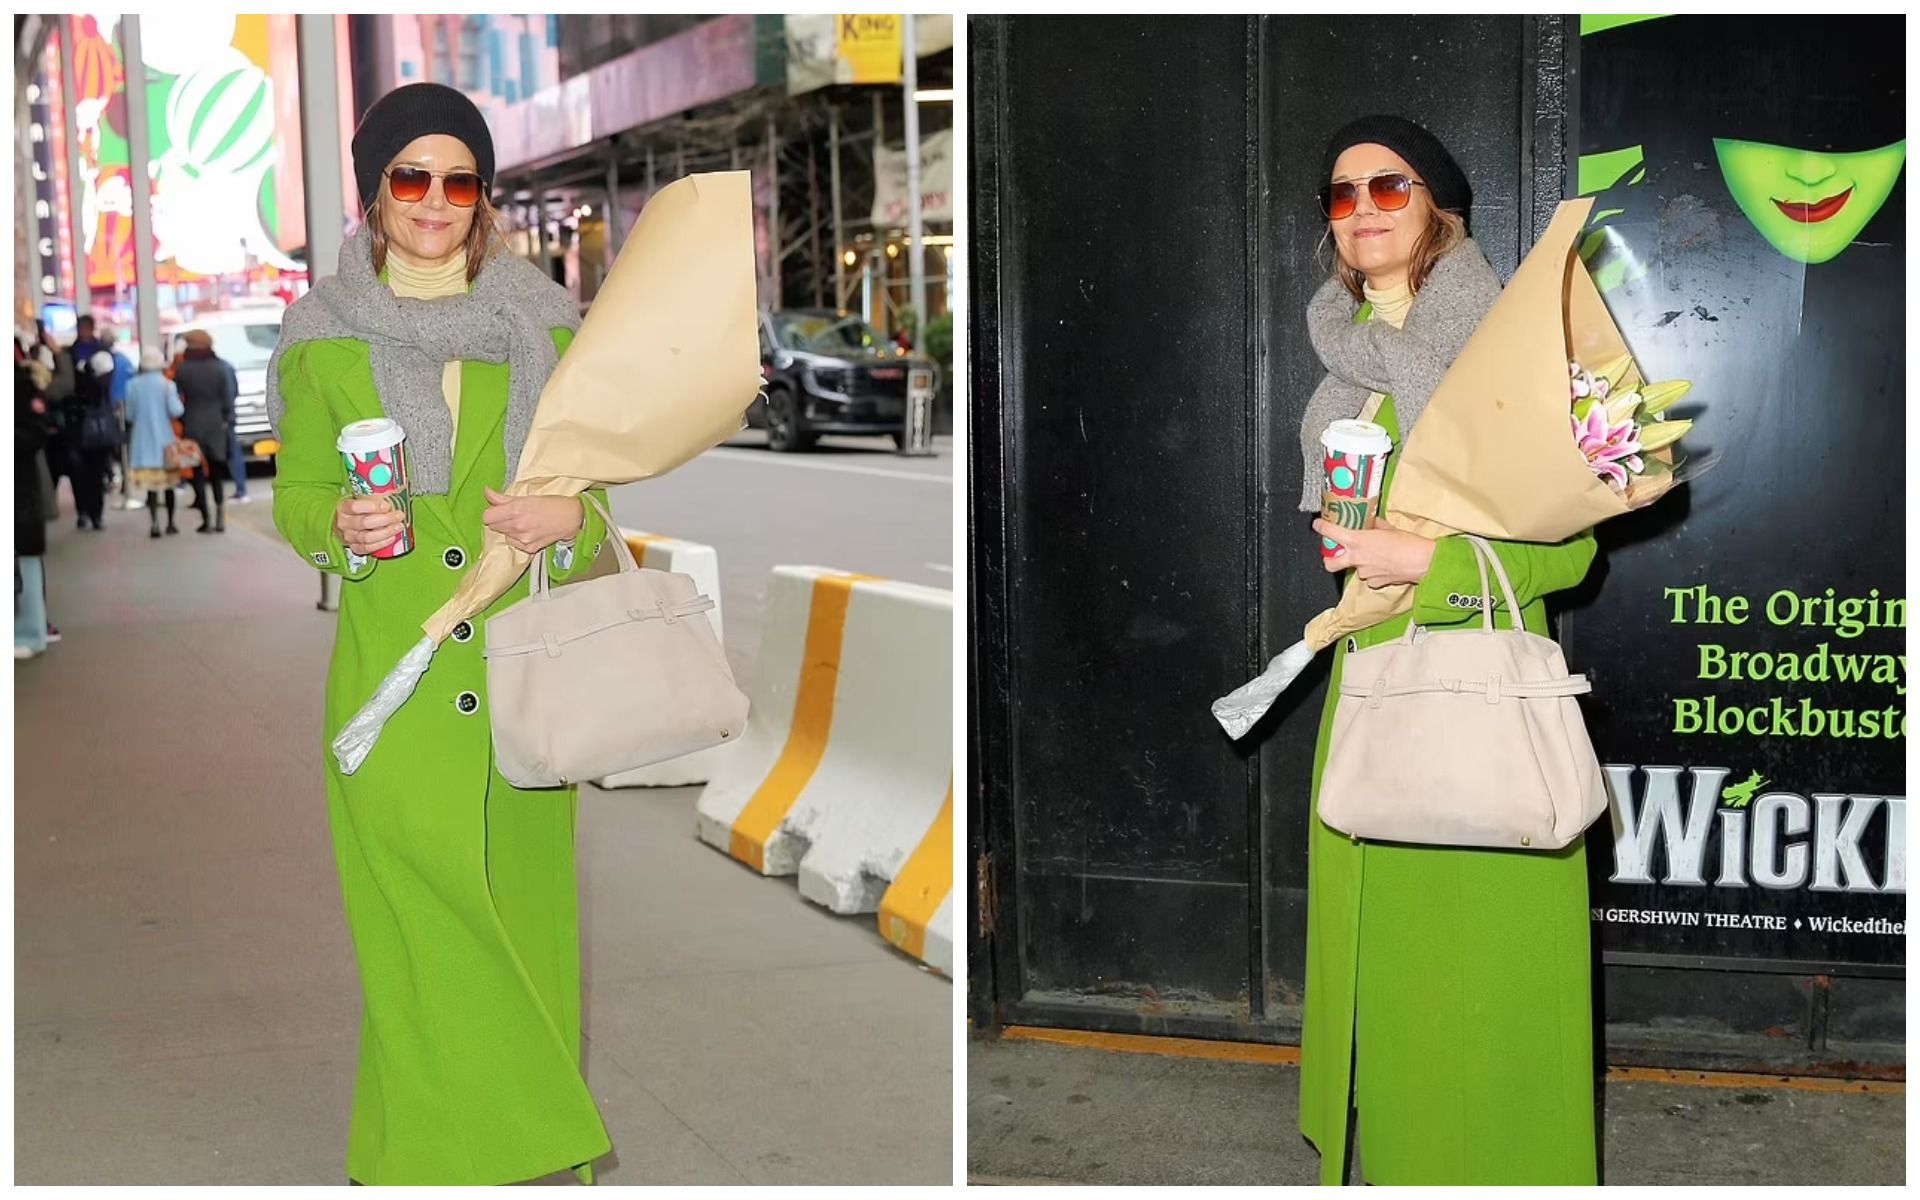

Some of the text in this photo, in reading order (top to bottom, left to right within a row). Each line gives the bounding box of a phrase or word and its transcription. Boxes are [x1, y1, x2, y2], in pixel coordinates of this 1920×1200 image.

[1664, 584, 1749, 625] The
[1672, 695, 1907, 739] Blockbust
[1606, 908, 1700, 926] GERSHWIN
[1704, 913, 1787, 930] THEATRE
[1808, 916, 1907, 935] Wickedthe
